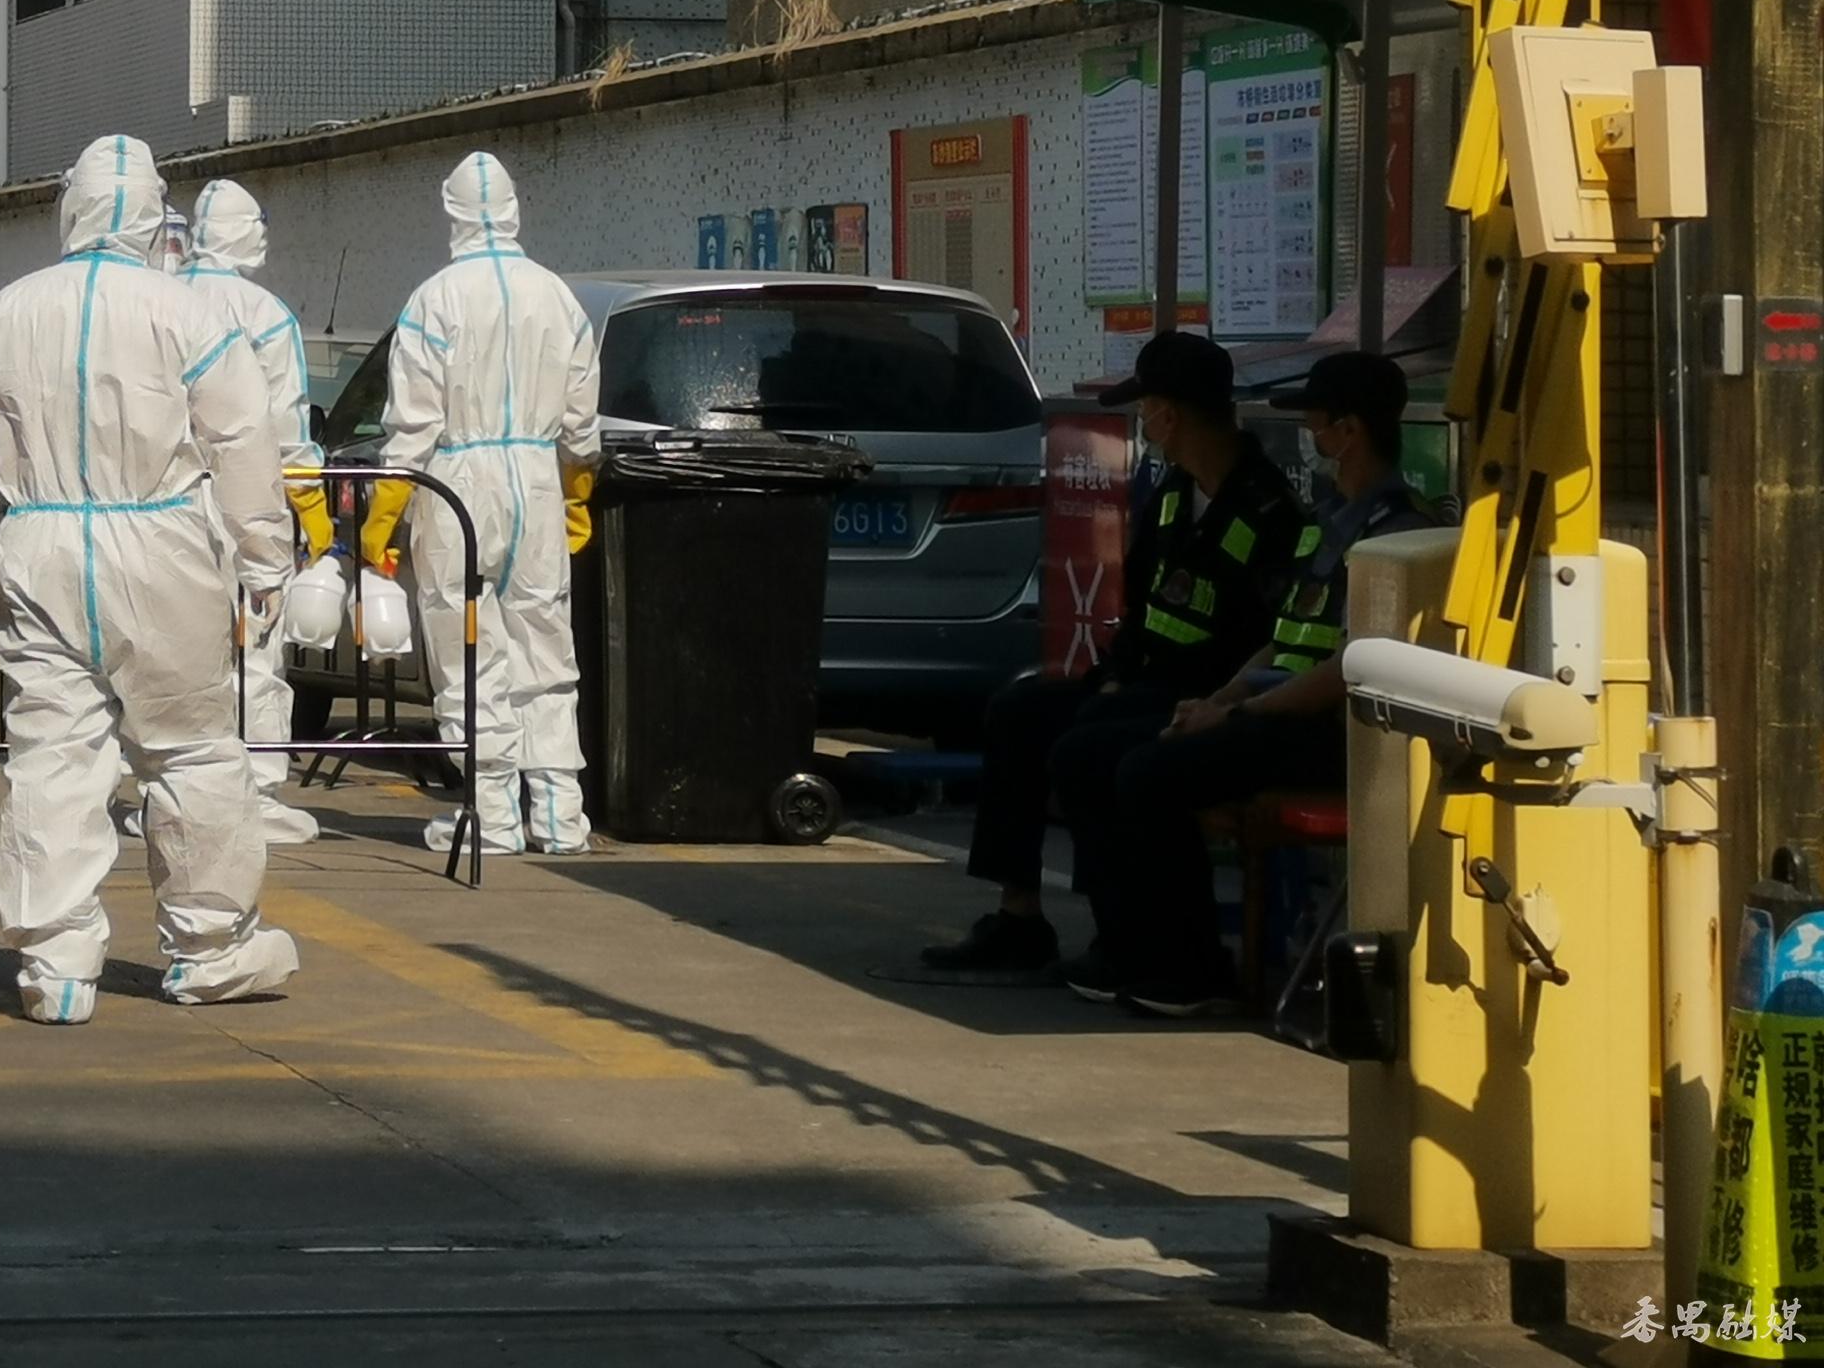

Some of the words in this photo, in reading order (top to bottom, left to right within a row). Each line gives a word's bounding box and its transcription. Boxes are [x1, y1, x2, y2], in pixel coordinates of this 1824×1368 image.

[834, 501, 908, 534] 6G13
[1781, 1031, 1819, 1274] 正规家庭维修
